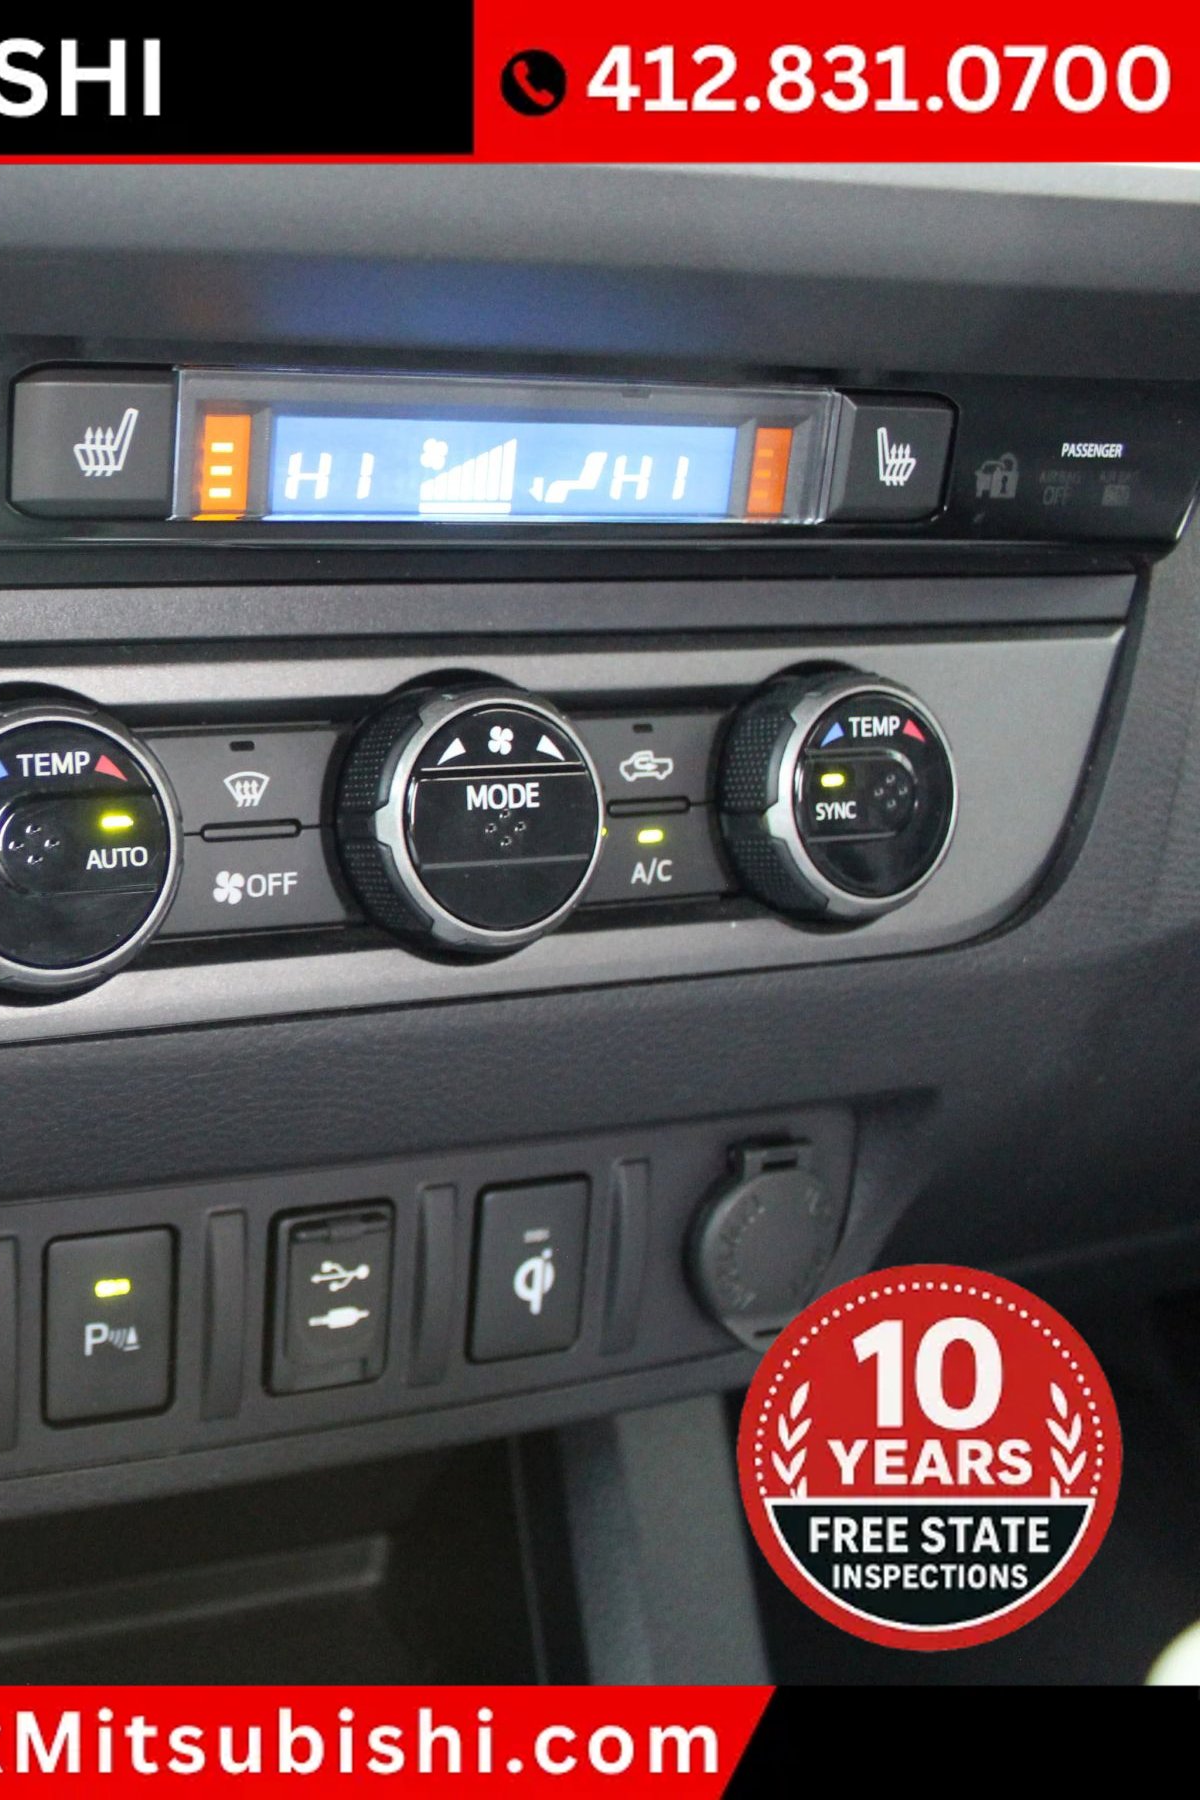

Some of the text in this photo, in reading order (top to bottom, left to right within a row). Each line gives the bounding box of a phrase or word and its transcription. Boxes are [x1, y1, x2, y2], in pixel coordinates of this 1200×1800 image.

[1061, 442, 1123, 458] PASSENGER
[848, 715, 900, 738] TEMP
[16, 751, 91, 777] TEMP
[466, 782, 540, 811] MODE
[815, 801, 857, 821] SYNC
[86, 846, 148, 870] AUTO
[631, 857, 673, 884] A/C
[246, 871, 298, 898] OFF
